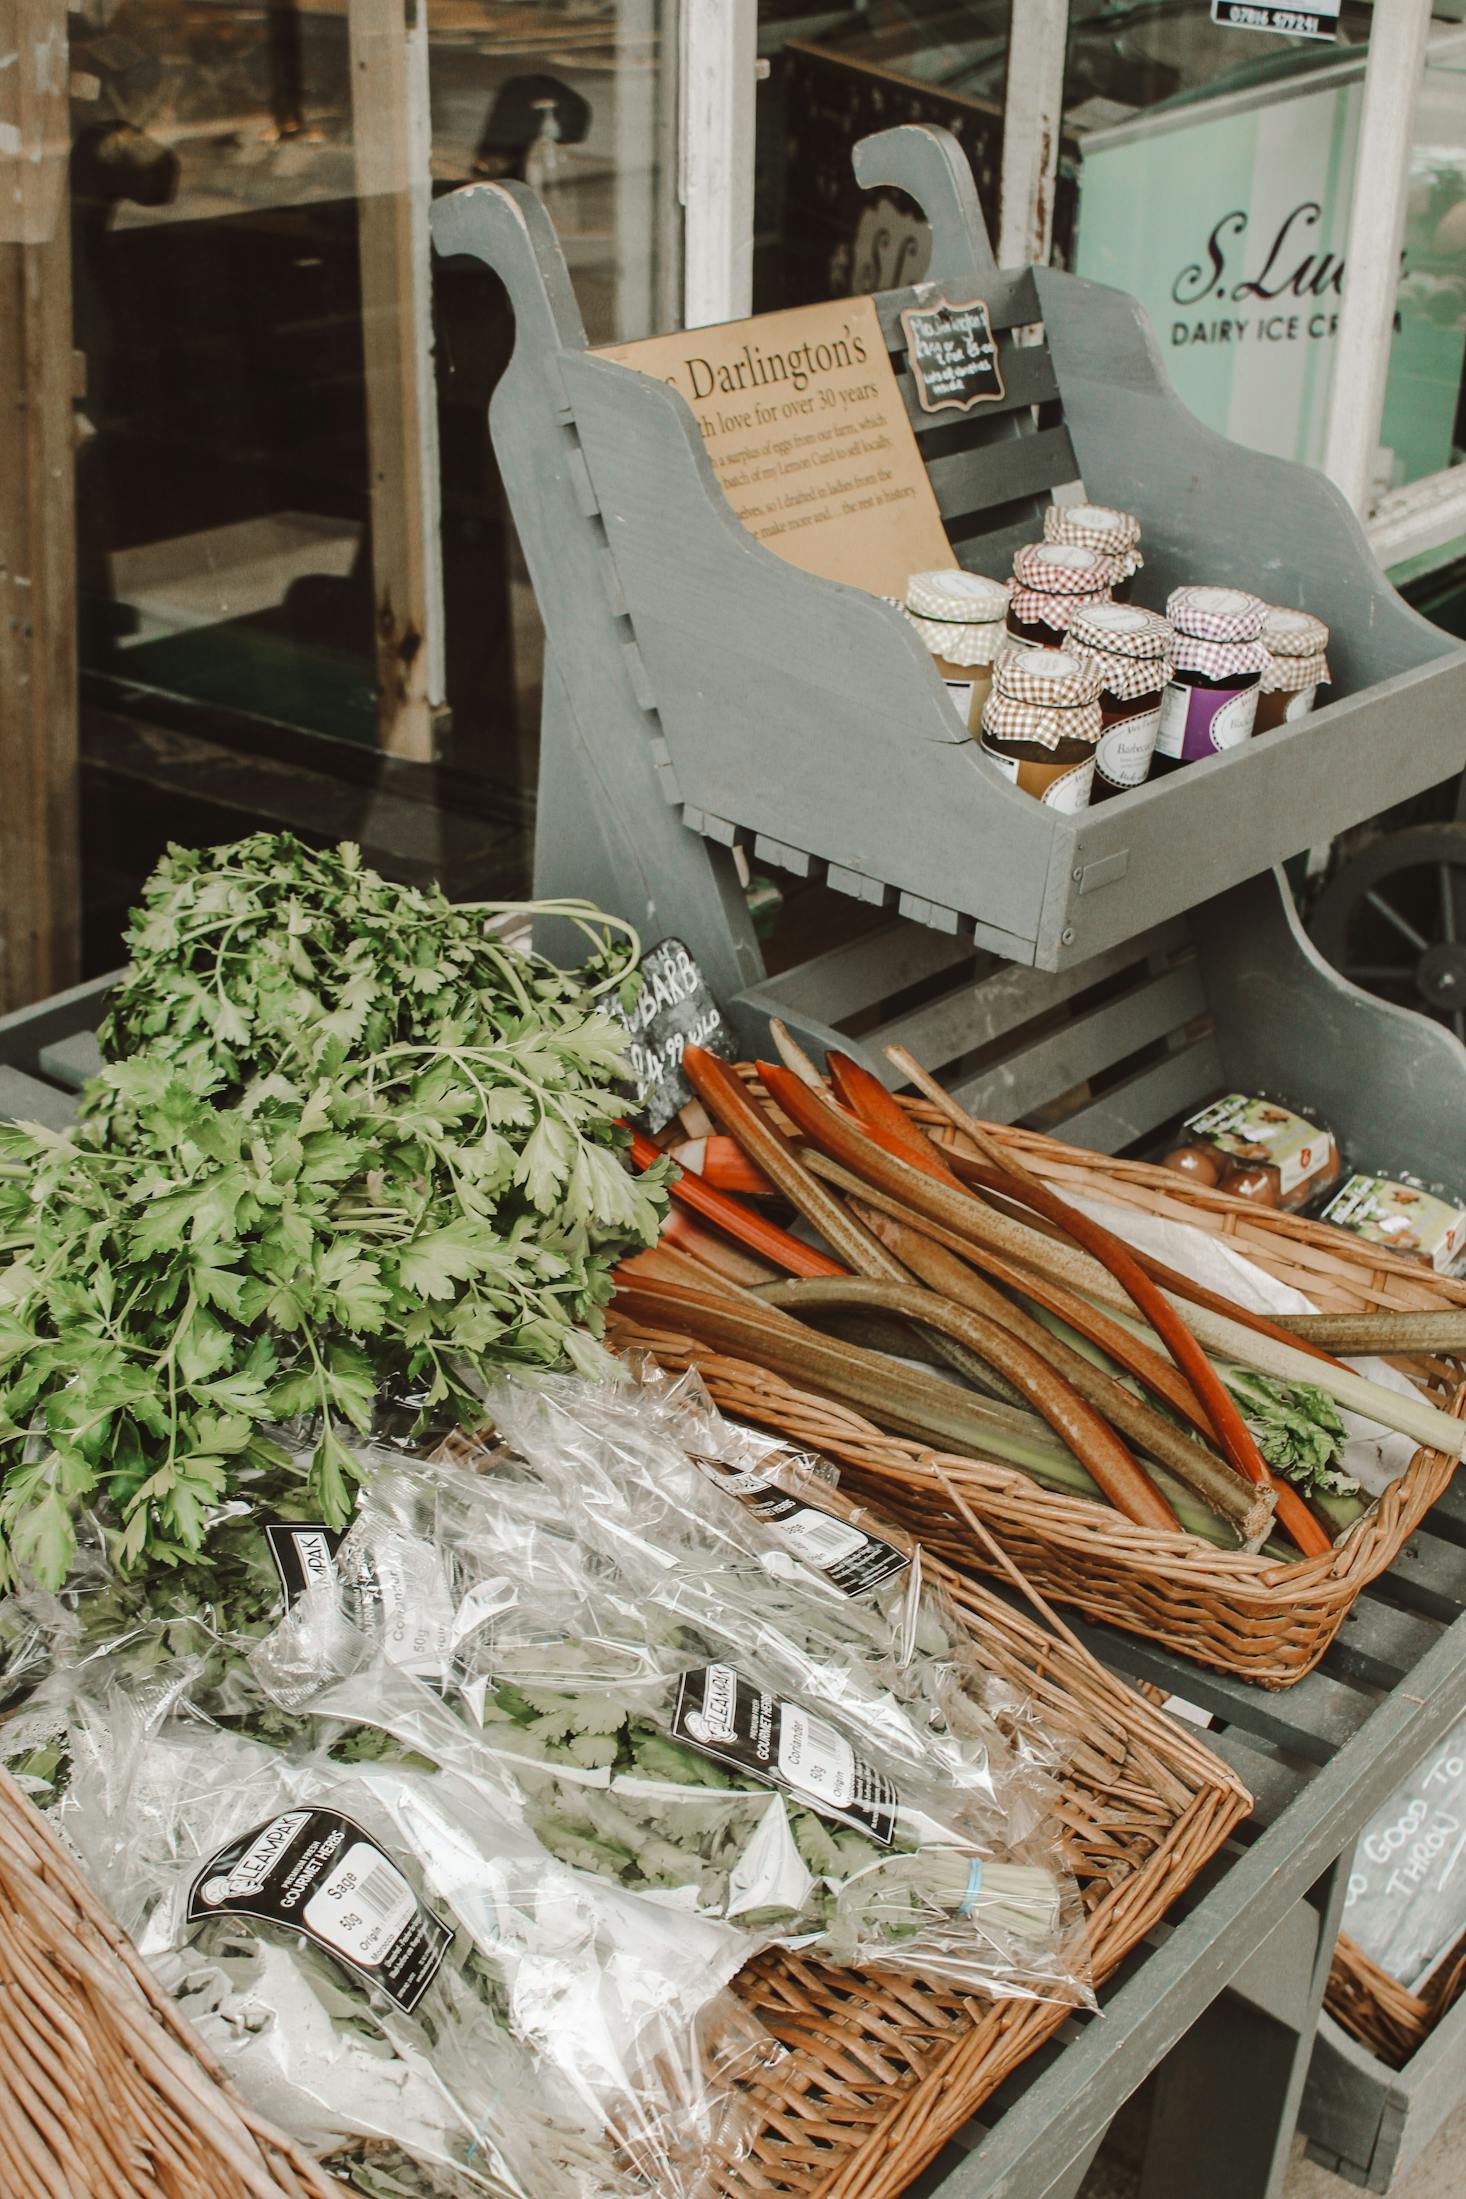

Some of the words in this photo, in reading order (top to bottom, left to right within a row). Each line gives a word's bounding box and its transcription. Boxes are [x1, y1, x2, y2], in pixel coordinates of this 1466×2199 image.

[1171, 317, 1249, 346] DAIRY
[1256, 314, 1299, 339] ICE
[685, 324, 868, 400] Darlington's
[717, 405, 751, 434] love
[753, 399, 777, 425] for
[782, 397, 814, 418] over
[818, 388, 837, 409] 30
[838, 381, 880, 411] years
[687, 1009, 720, 1047] KILO
[413, 1628, 429, 1652] 50g
[756, 1716, 773, 1760] GOURMET
[788, 1720, 806, 1765] Coriander
[832, 1770, 845, 1797] Origin
[1363, 1799, 1428, 1864] GOOD
[1422, 1756, 1464, 1790] TO
[240, 1812, 304, 1881] LEAMPAK
[281, 1859, 306, 1889] PREMIUM
[302, 1840, 320, 1861] FRESH
[1385, 1810, 1460, 1895] THROW
[280, 1859, 324, 1908] GOURMET
[316, 1830, 346, 1862] HERBS
[327, 1871, 357, 1900] Sage
[340, 1912, 362, 1931] 50g
[359, 1925, 382, 1951] Origin
[370, 1934, 395, 1961] Morocco
